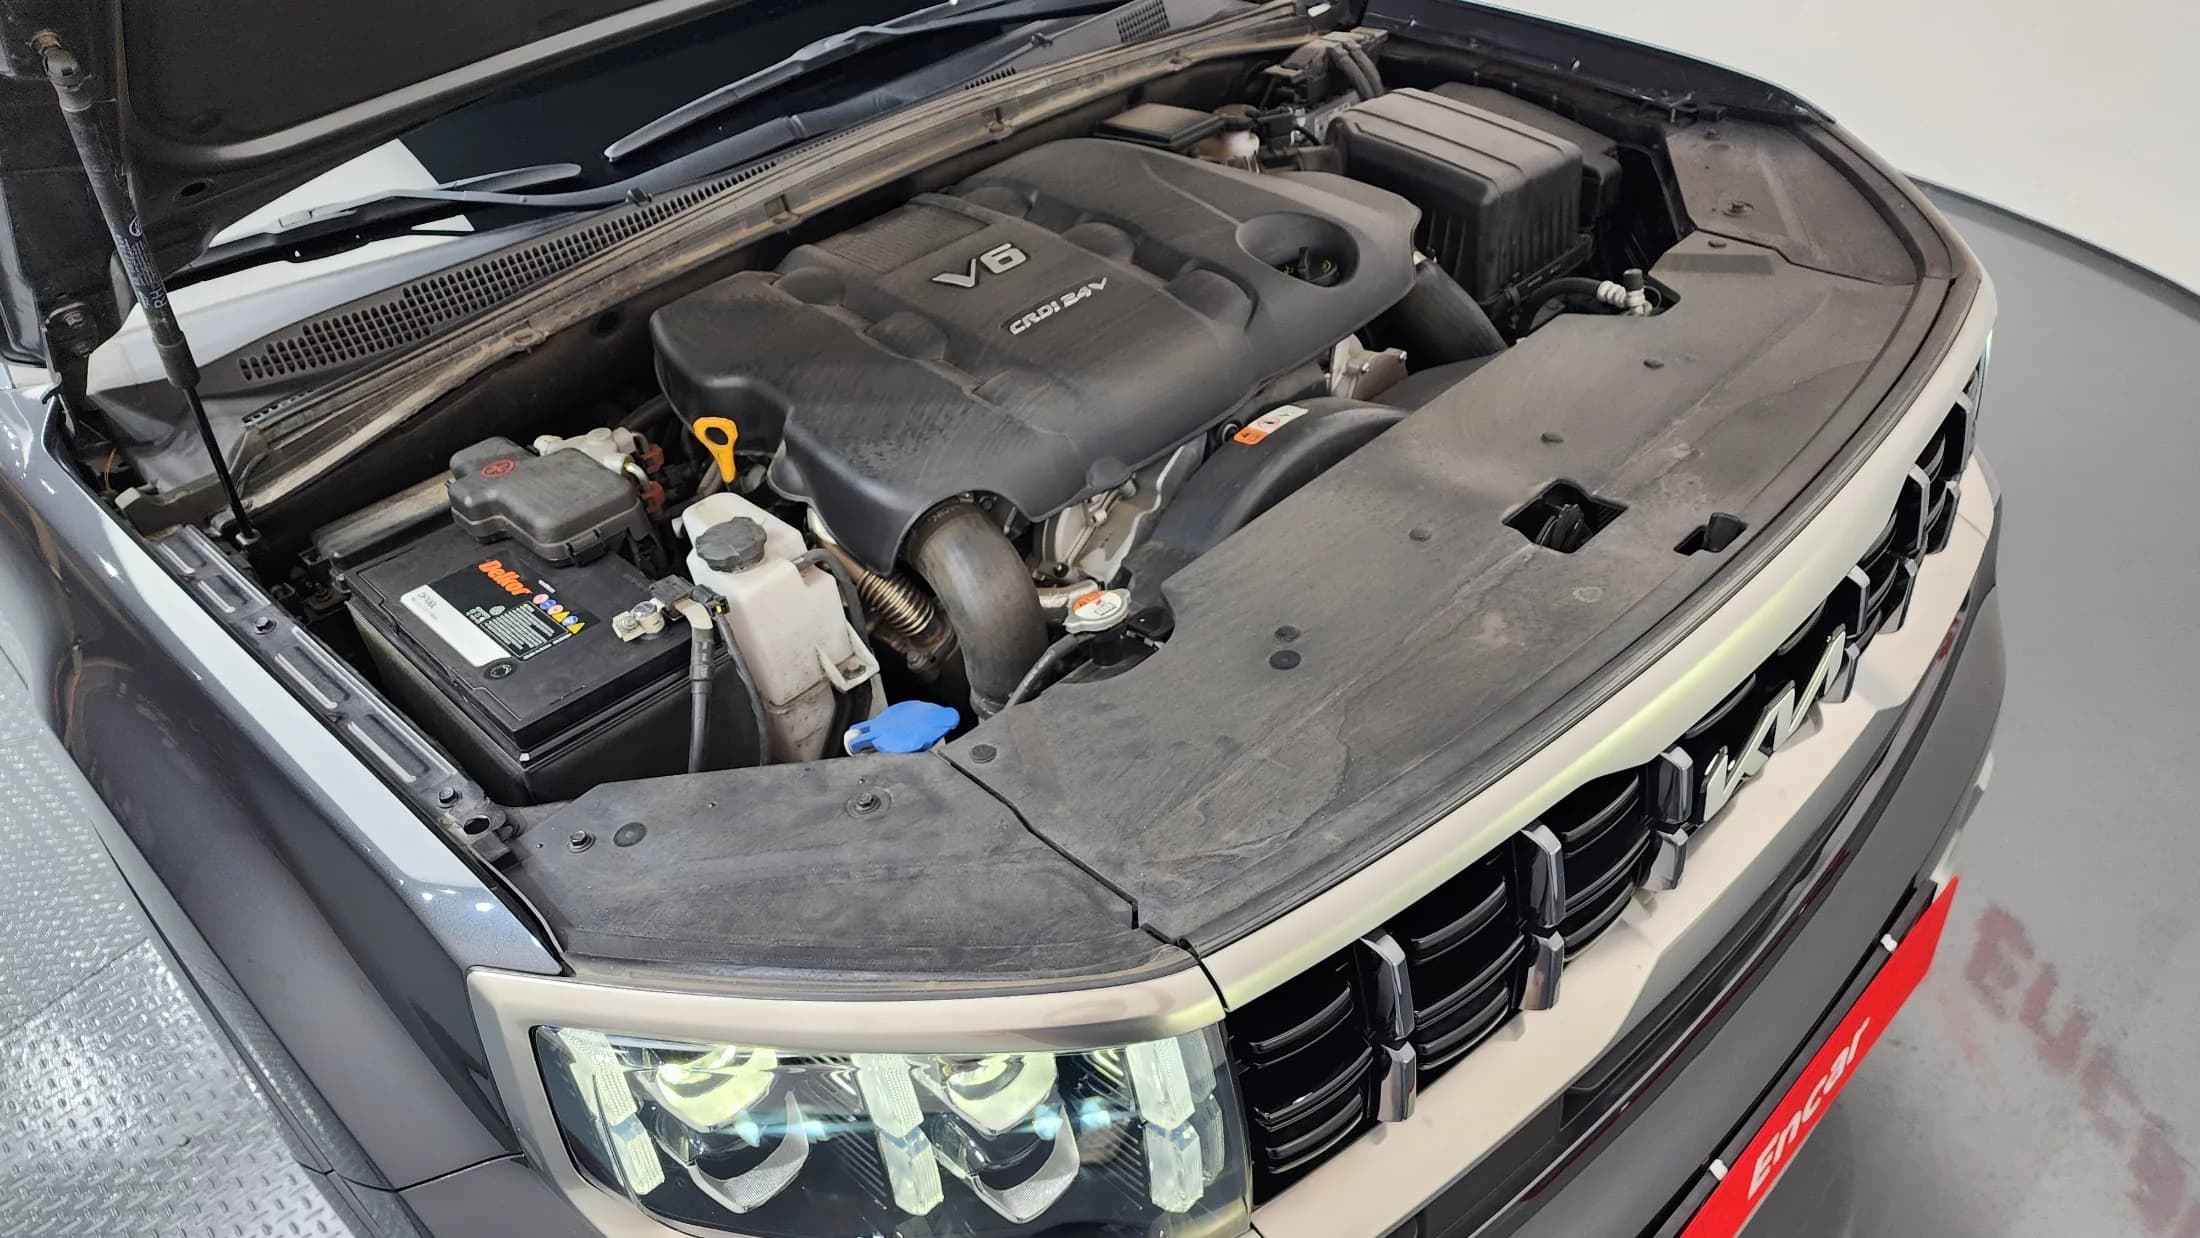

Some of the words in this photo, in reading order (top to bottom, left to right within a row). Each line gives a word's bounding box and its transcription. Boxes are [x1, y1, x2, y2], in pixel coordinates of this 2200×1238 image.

[931, 242, 1028, 288] V6
[150, 287, 168, 308] RH
[1060, 276, 1107, 308] 24V
[1703, 625, 1846, 822] KIA
[1747, 1016, 1871, 1201] Encar
